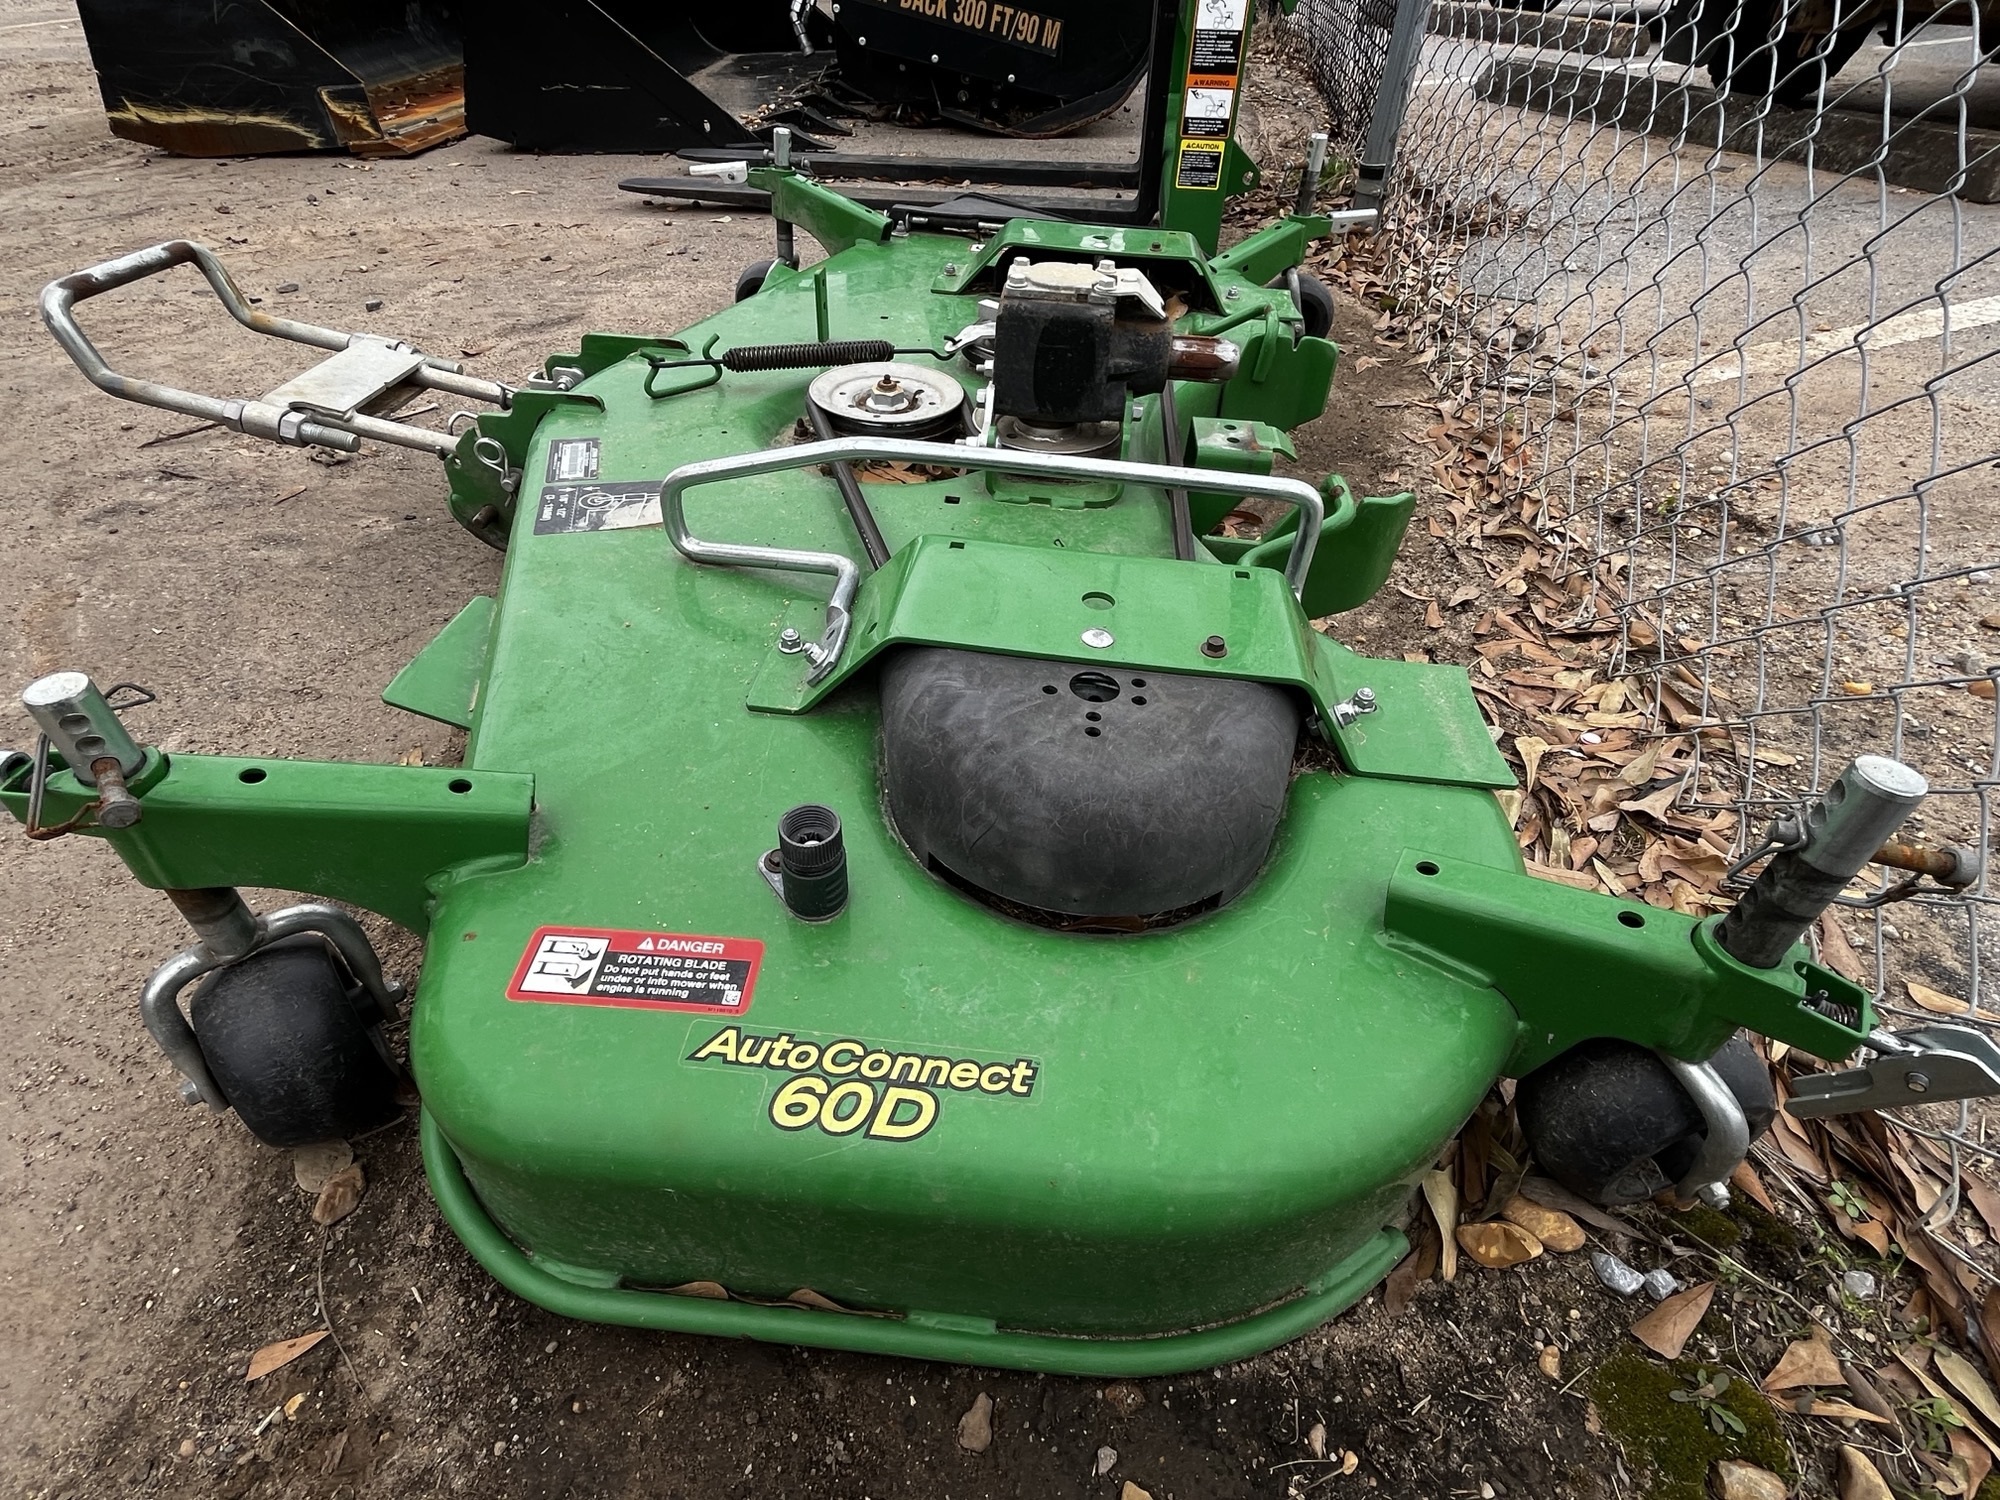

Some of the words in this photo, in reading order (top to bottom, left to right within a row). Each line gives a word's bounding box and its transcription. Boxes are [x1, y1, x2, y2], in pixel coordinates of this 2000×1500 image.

[900, 0, 948, 20] CK
[952, 0, 986, 30] 300
[989, 4, 1040, 44] FT/90
[1041, 18, 1062, 50] M
[1200, 79, 1230, 87] WARNING
[656, 938, 725, 955] DANGER
[617, 954, 682, 968] ROTATING
[684, 959, 727, 971] BLADE
[603, 964, 620, 974] Do
[621, 966, 640, 975] not
[640, 968, 660, 977] put
[661, 968, 694, 979] hands
[696, 972, 708, 980] or
[709, 972, 731, 981] feet
[596, 983, 633, 994] engine
[634, 985, 645, 994] is
[646, 986, 690, 999] running
[600, 974, 632, 984] under
[633, 977, 646, 985] or
[647, 976, 669, 986] into
[670, 979, 707, 989] mower
[709, 981, 738, 991] when
[687, 1026, 1040, 1097] AutoConnect
[768, 1073, 940, 1142] 60D
